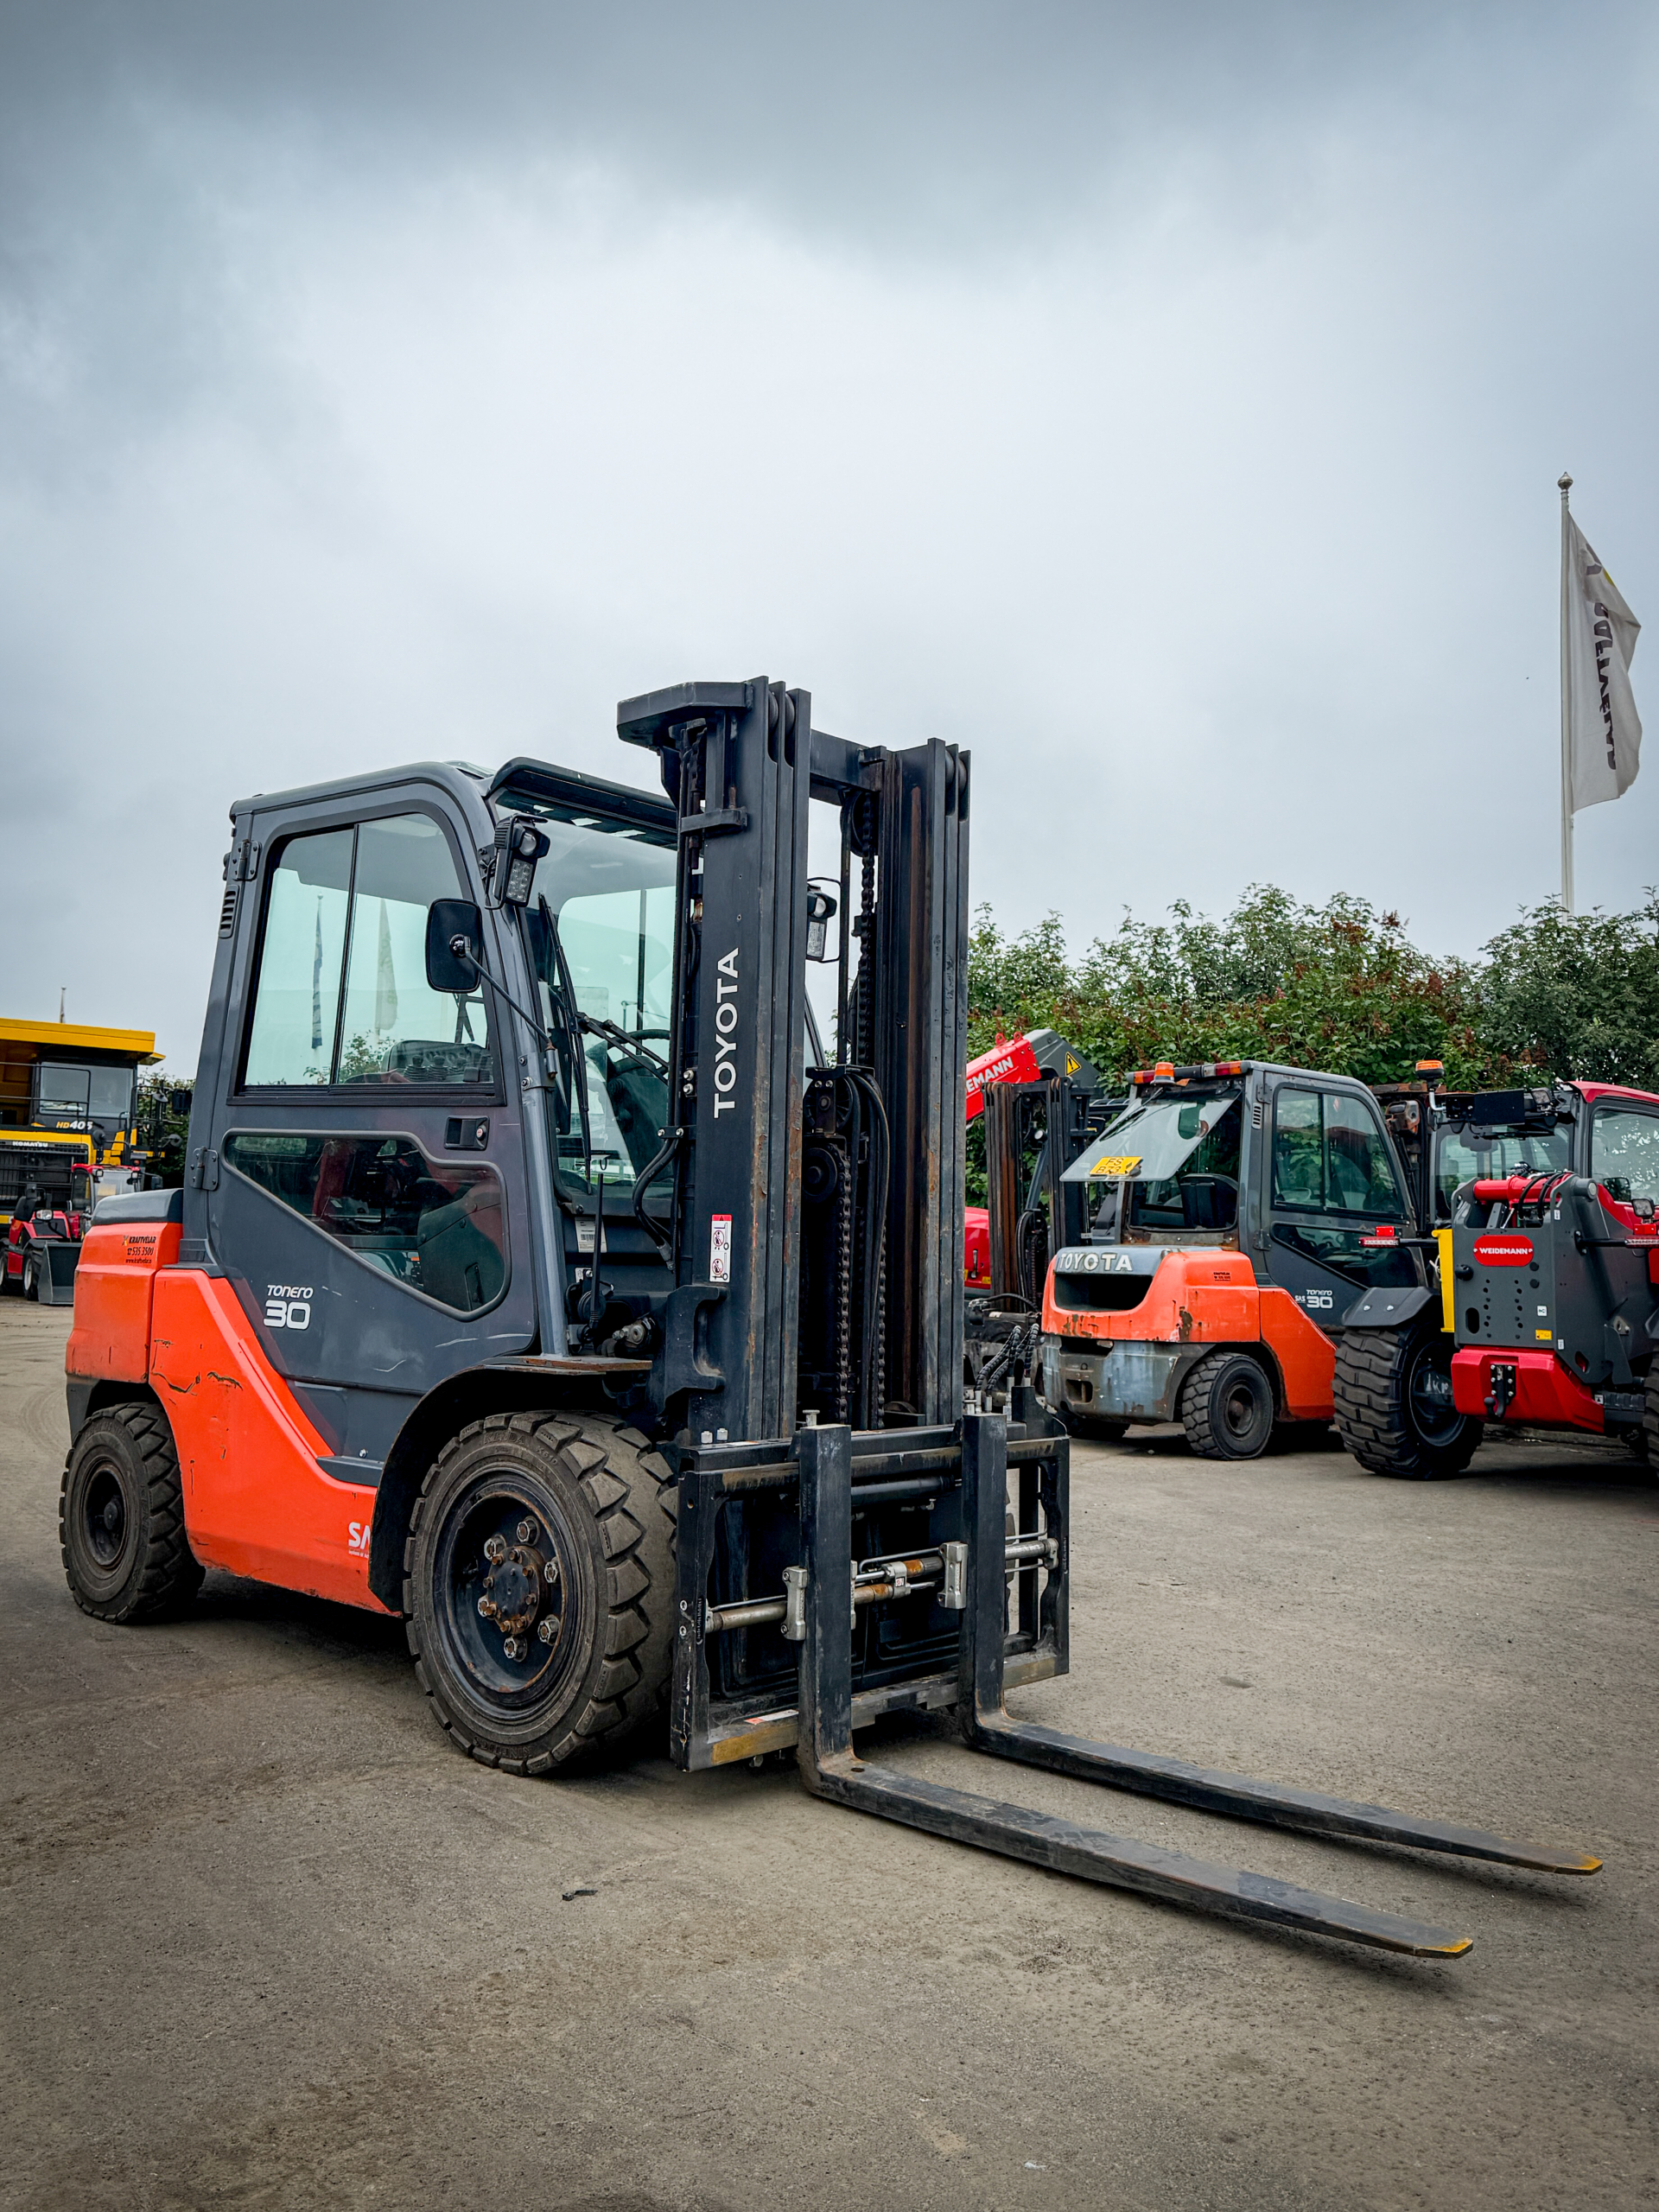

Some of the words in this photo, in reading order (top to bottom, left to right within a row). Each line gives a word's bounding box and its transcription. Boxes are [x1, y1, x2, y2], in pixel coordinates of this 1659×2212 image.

[714, 947, 739, 1119] TOYOTA
[966, 1056, 1014, 1093] EMANN
[55, 1120, 93, 1130] HD405
[132, 1246, 141, 1255] 535
[142, 1246, 154, 1255] 3500
[1059, 1253, 1134, 1272] TOYOTA
[267, 1284, 314, 1299] TONERO
[1306, 1296, 1333, 1309] 30
[264, 1300, 311, 1330] 30
[484, 1430, 525, 1445] KENDA
[348, 1522, 372, 1550] SA
